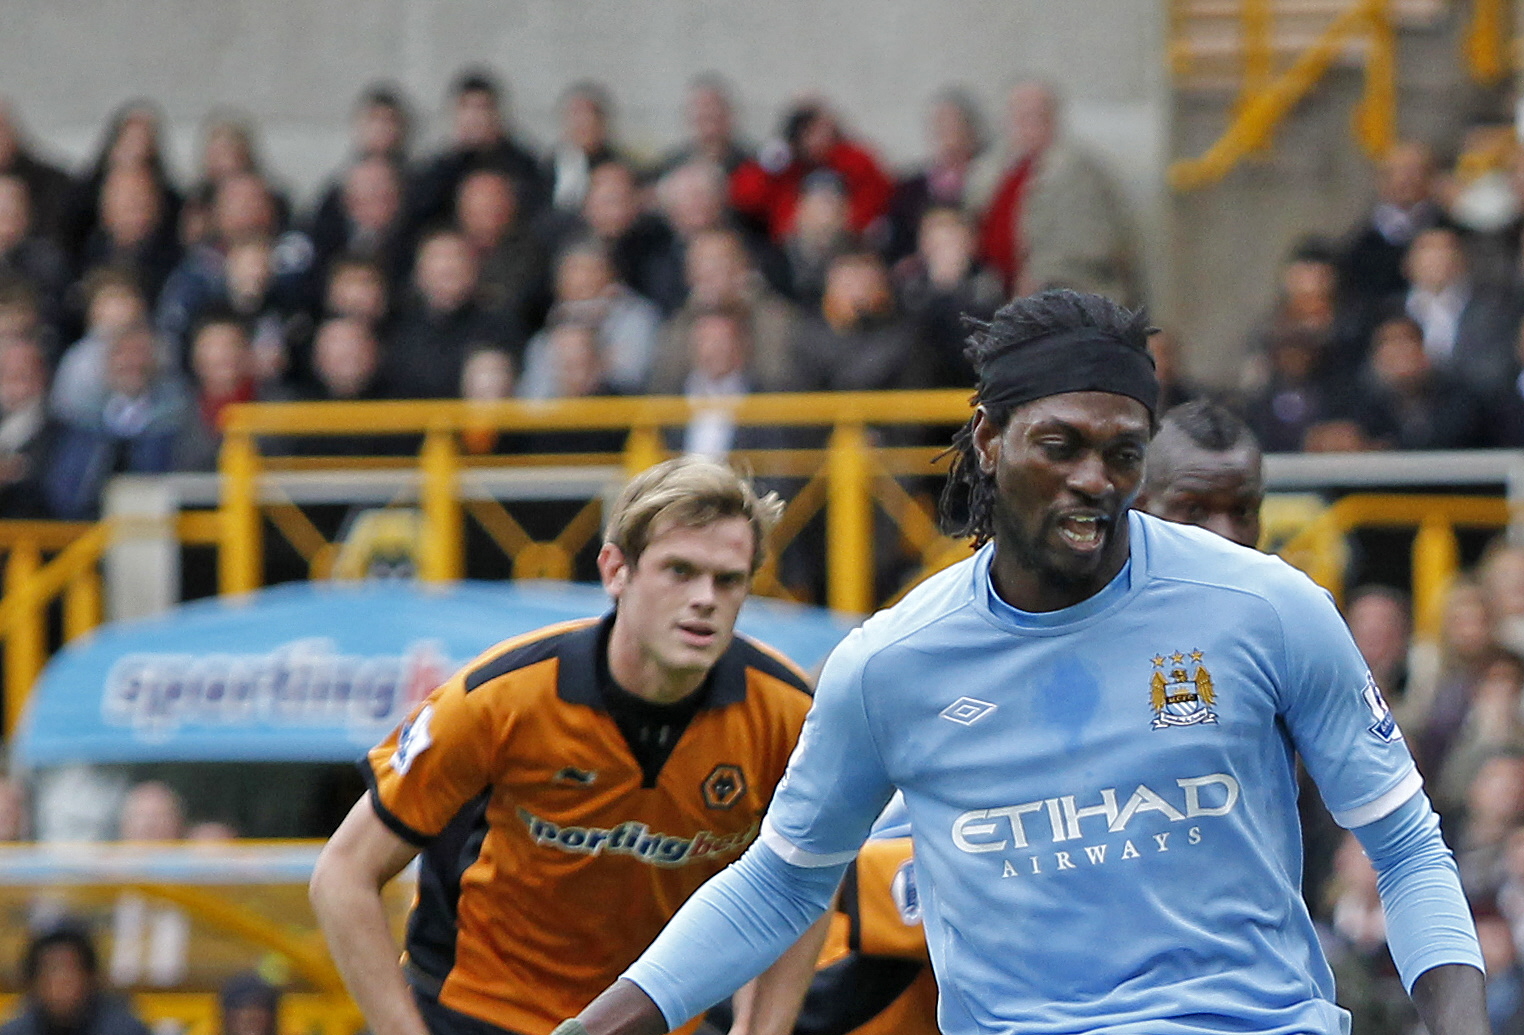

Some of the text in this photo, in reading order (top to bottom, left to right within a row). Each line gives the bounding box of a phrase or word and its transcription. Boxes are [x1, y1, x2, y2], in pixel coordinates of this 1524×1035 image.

[951, 773, 1239, 853] ETIHAD
[520, 816, 757, 868] portingbe
[1001, 826, 1202, 878] AIRWAYS
